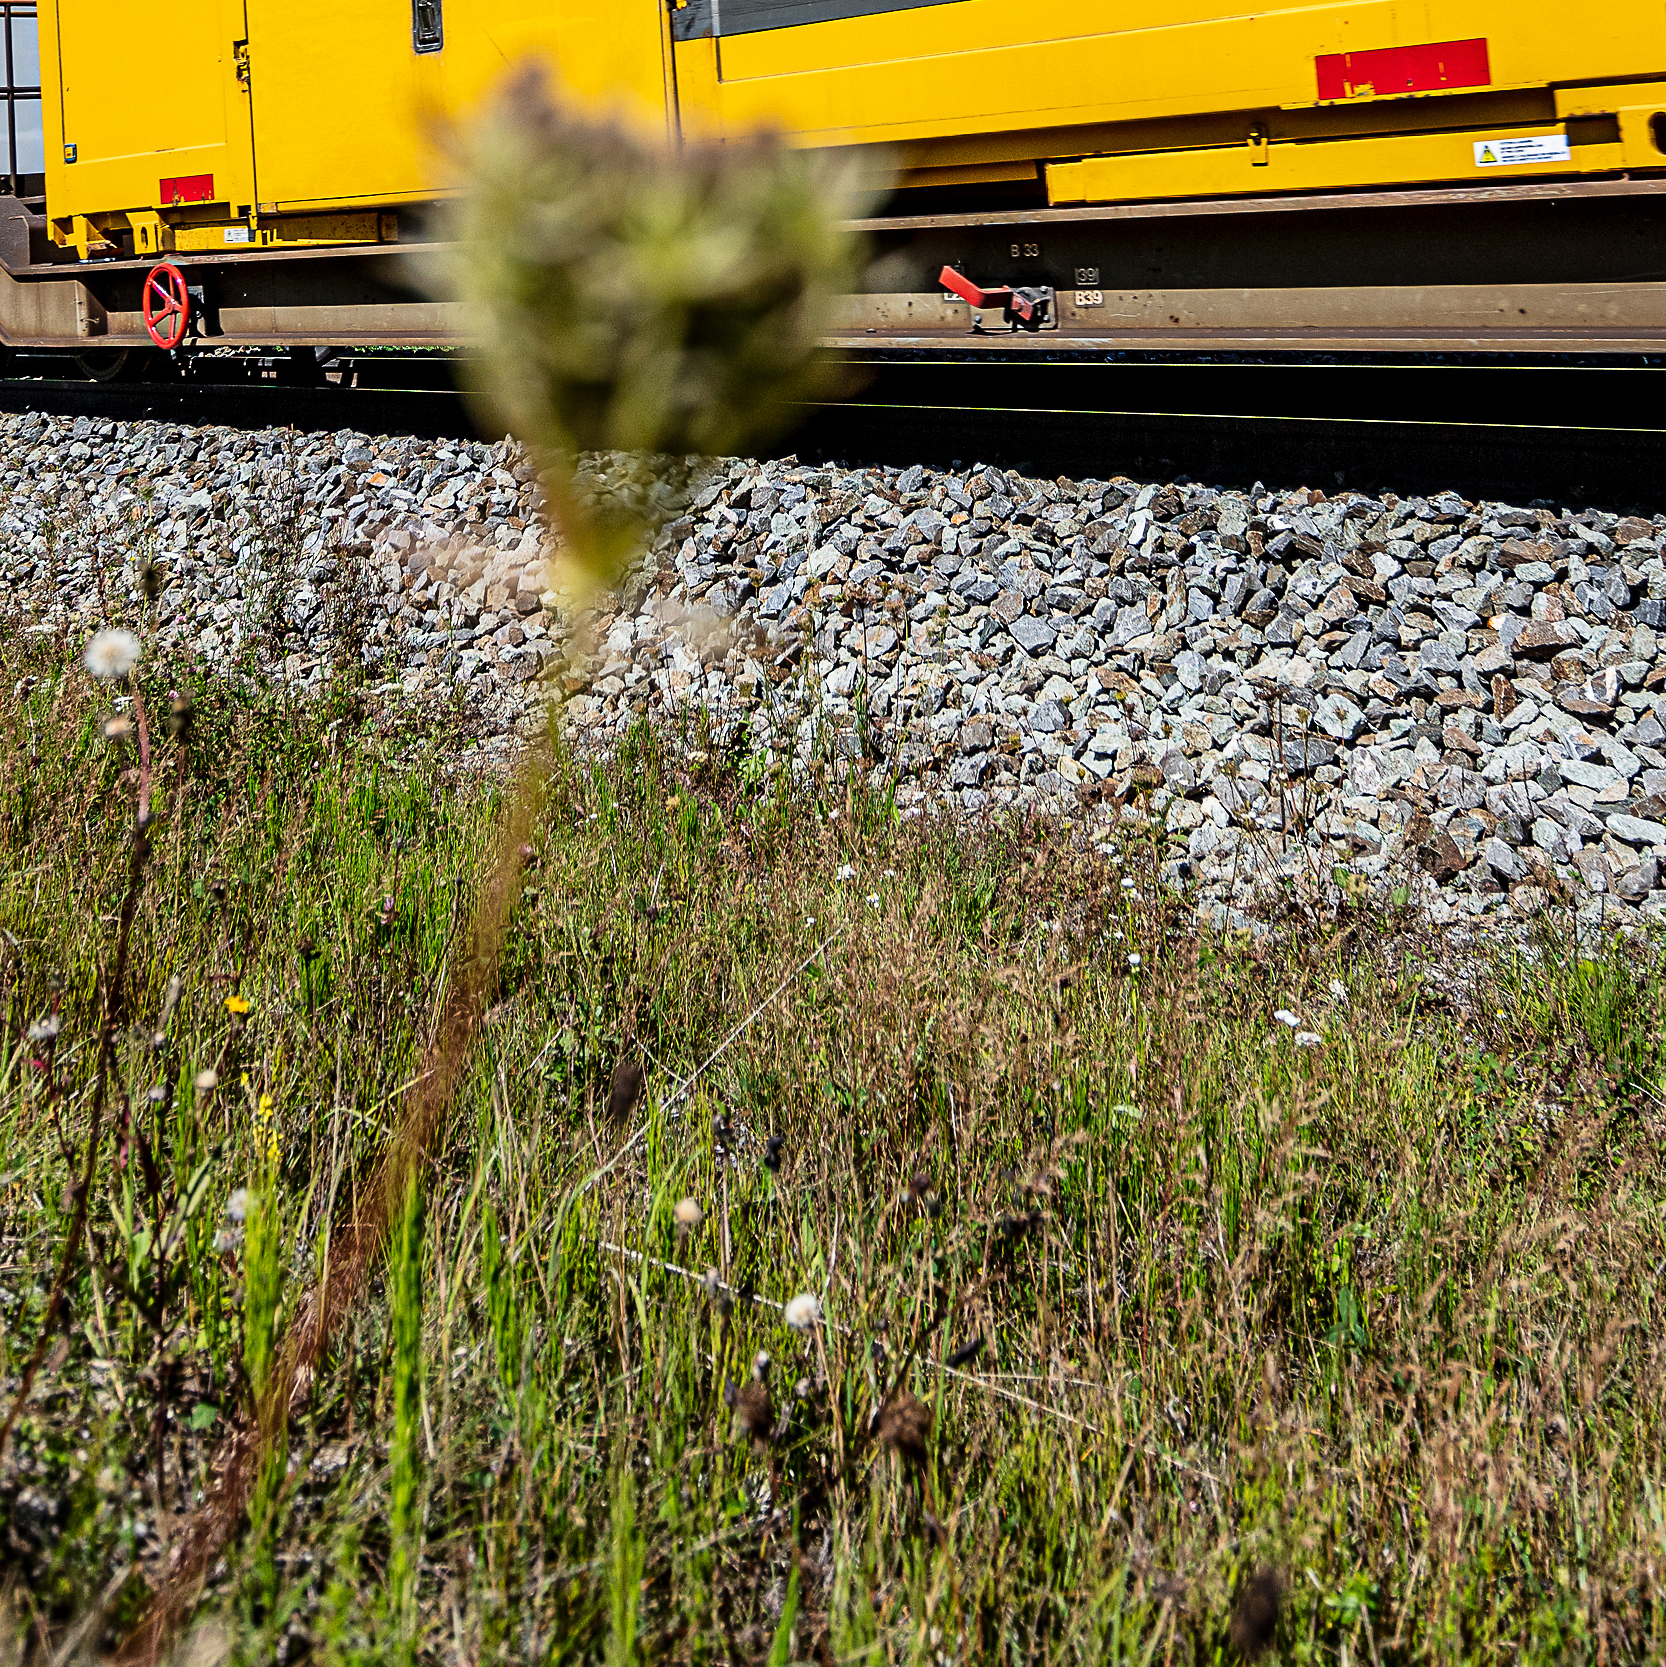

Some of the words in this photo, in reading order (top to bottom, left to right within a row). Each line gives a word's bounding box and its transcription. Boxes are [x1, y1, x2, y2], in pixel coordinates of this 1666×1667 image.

[1010, 244, 1020, 258] B
[1023, 243, 1040, 258] 33
[1074, 290, 1104, 306] B39
